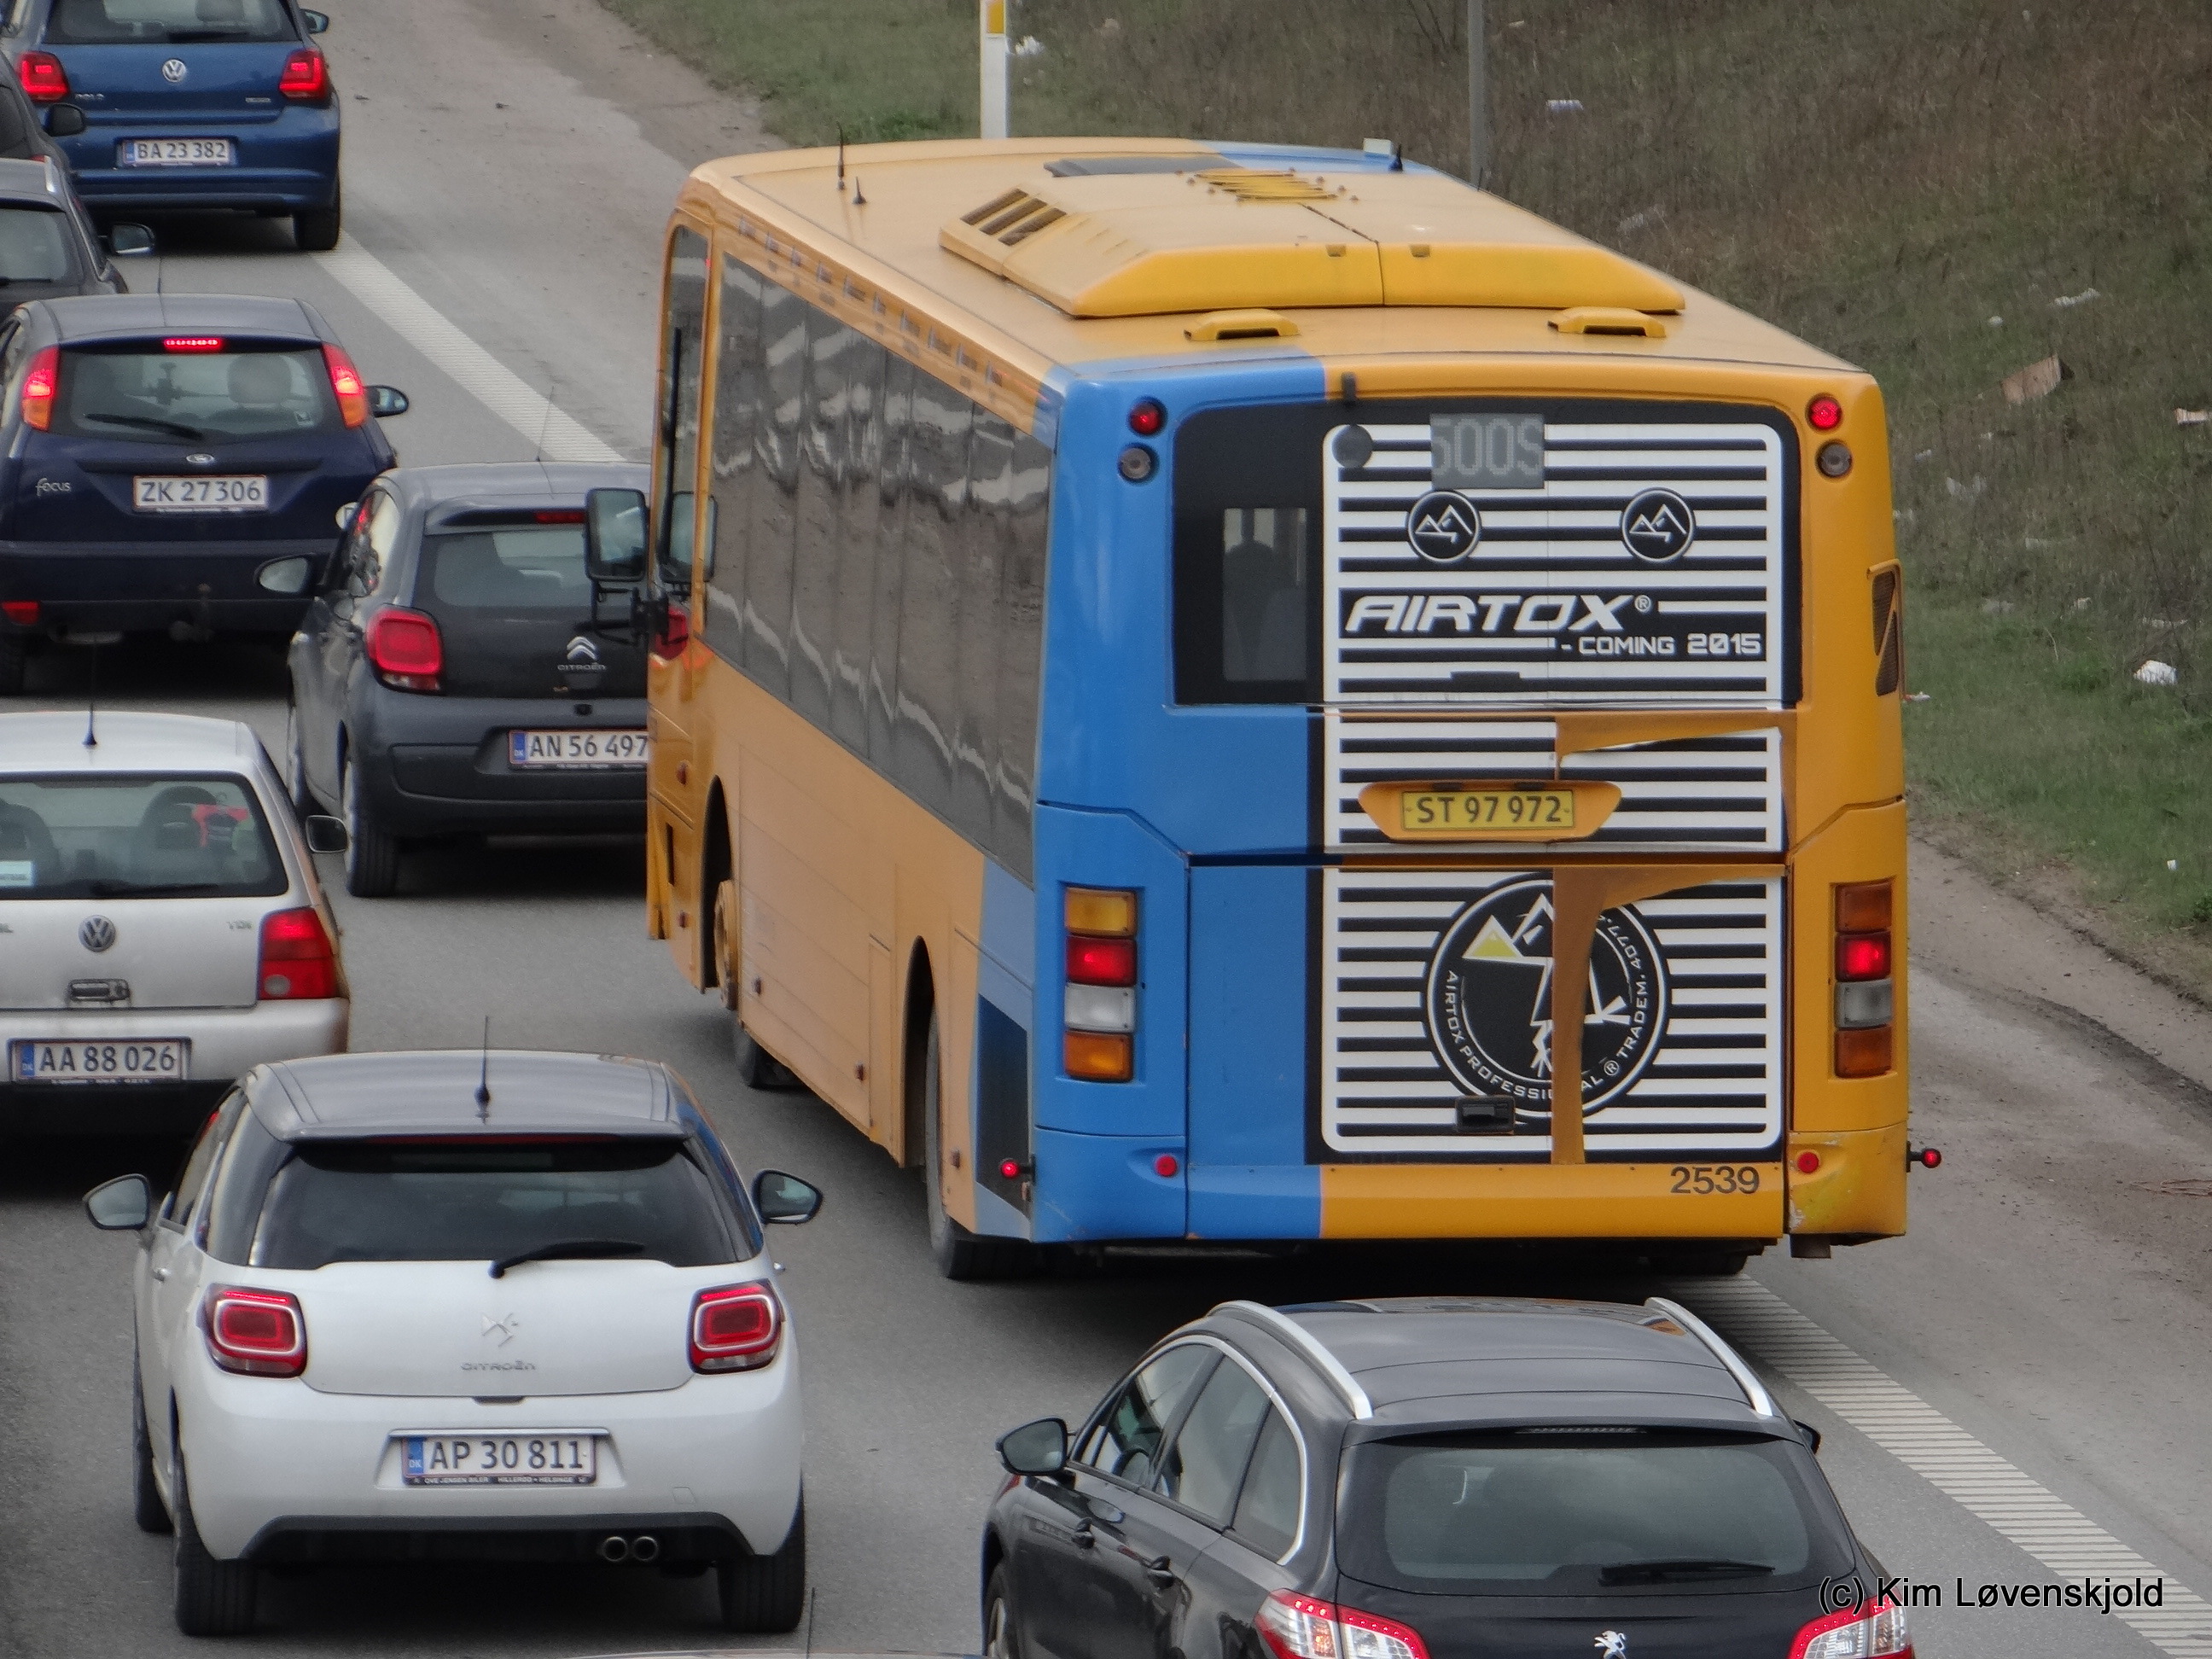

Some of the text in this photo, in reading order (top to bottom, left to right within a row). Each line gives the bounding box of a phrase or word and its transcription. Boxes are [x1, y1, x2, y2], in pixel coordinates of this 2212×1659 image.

[137, 142, 226, 159] BA 23 382
[141, 480, 260, 502] ZK 27 306
[1578, 636, 1675, 655] COMING
[1687, 632, 1762, 655] 2015
[529, 734, 648, 757] AN 56 497
[1417, 795, 1562, 823] ST 97 972
[1445, 970, 1465, 1044] AIRTOX
[1460, 1046, 1604, 1099] PROFESSIAL
[39, 1045, 175, 1072] AA 88 026
[1670, 1166, 1760, 1194] 2539
[409, 1458, 422, 1468] DK
[429, 1440, 583, 1470] AP 30 811
